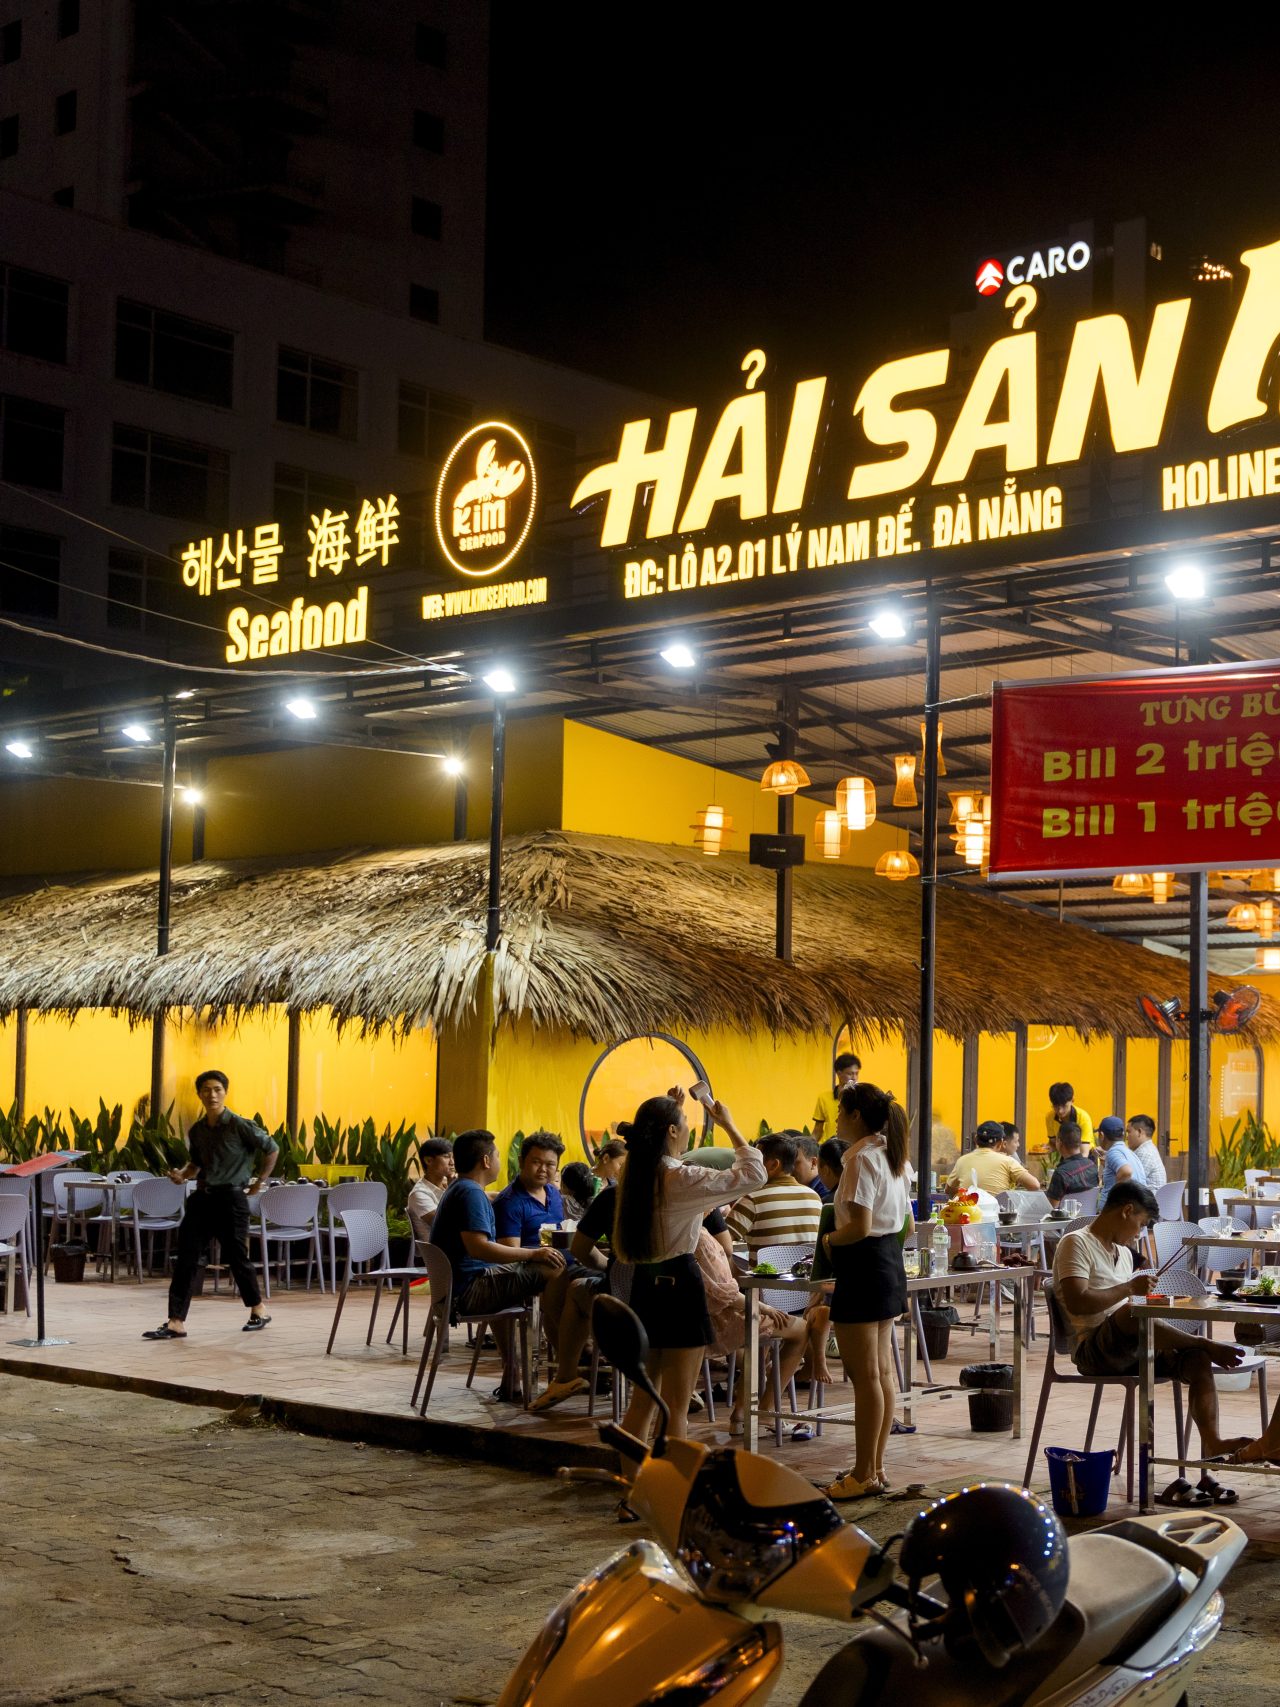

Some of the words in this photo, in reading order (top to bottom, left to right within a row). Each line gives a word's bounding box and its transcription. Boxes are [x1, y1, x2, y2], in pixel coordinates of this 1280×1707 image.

[1006, 241, 1090, 285] CARO
[571, 349, 828, 548] HẢI
[848, 284, 1192, 500] SẢN
[181, 523, 284, 596] 해산물
[307, 494, 400, 578] 海鲜
[458, 531, 506, 552] SEAFOOD
[624, 559, 663, 599] ĐC:
[667, 543, 698, 592] LÔ
[700, 539, 766, 586] A2.01
[772, 522, 803, 575] LÝ
[807, 519, 870, 569] NAM
[933, 493, 972, 548] ĐÀ
[978, 477, 1062, 541] NẴNG
[422, 594, 445, 620] WEB:
[445, 577, 547, 617] WWW.KIMSEAFOOD.COM
[225, 586, 368, 663] Seafood
[1043, 747, 1116, 782] Bill
[1136, 743, 1166, 775] 2
[1042, 804, 1115, 838] Bill
[1138, 801, 1156, 832] 1
